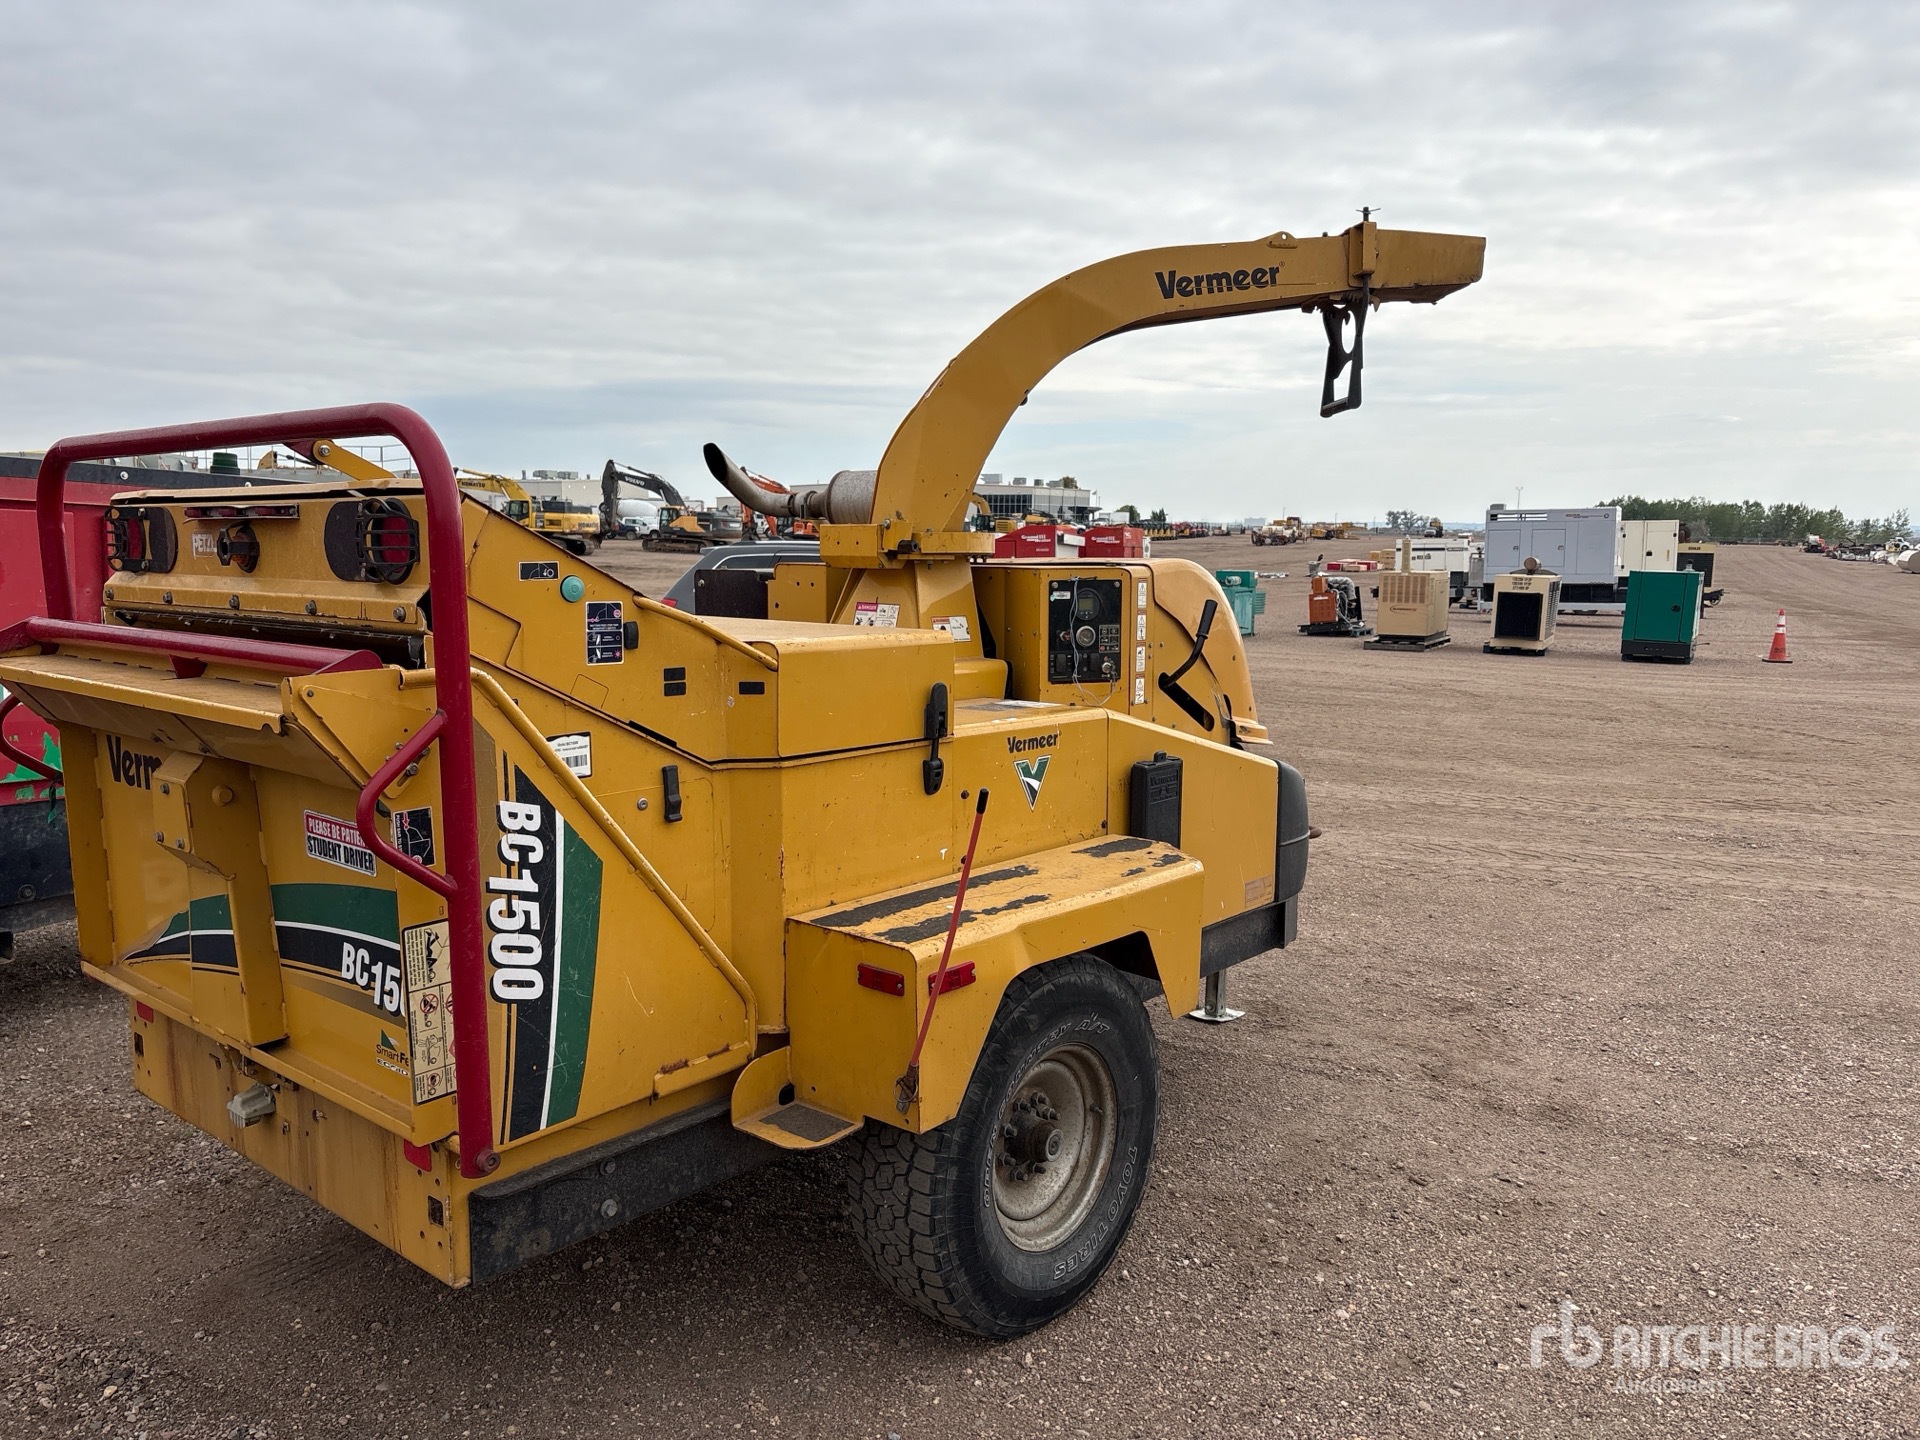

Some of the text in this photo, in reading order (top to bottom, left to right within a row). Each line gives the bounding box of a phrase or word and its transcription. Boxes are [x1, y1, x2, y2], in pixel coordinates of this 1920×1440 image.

[1154, 265, 1280, 299] Vermeer
[624, 476, 645, 487] VOLVO
[1006, 733, 1058, 753] Vermeer
[106, 733, 163, 790] Verm
[308, 817, 366, 848] PLEASE BE PATIEN
[307, 834, 374, 872] STUDENT DRIVER
[486, 800, 544, 1000] BC1500
[341, 941, 406, 1018] BC15
[1075, 1019, 1111, 1034] A/T
[376, 1043, 410, 1067] SmartFe
[1053, 1145, 1138, 1280] TOYO TIRES
